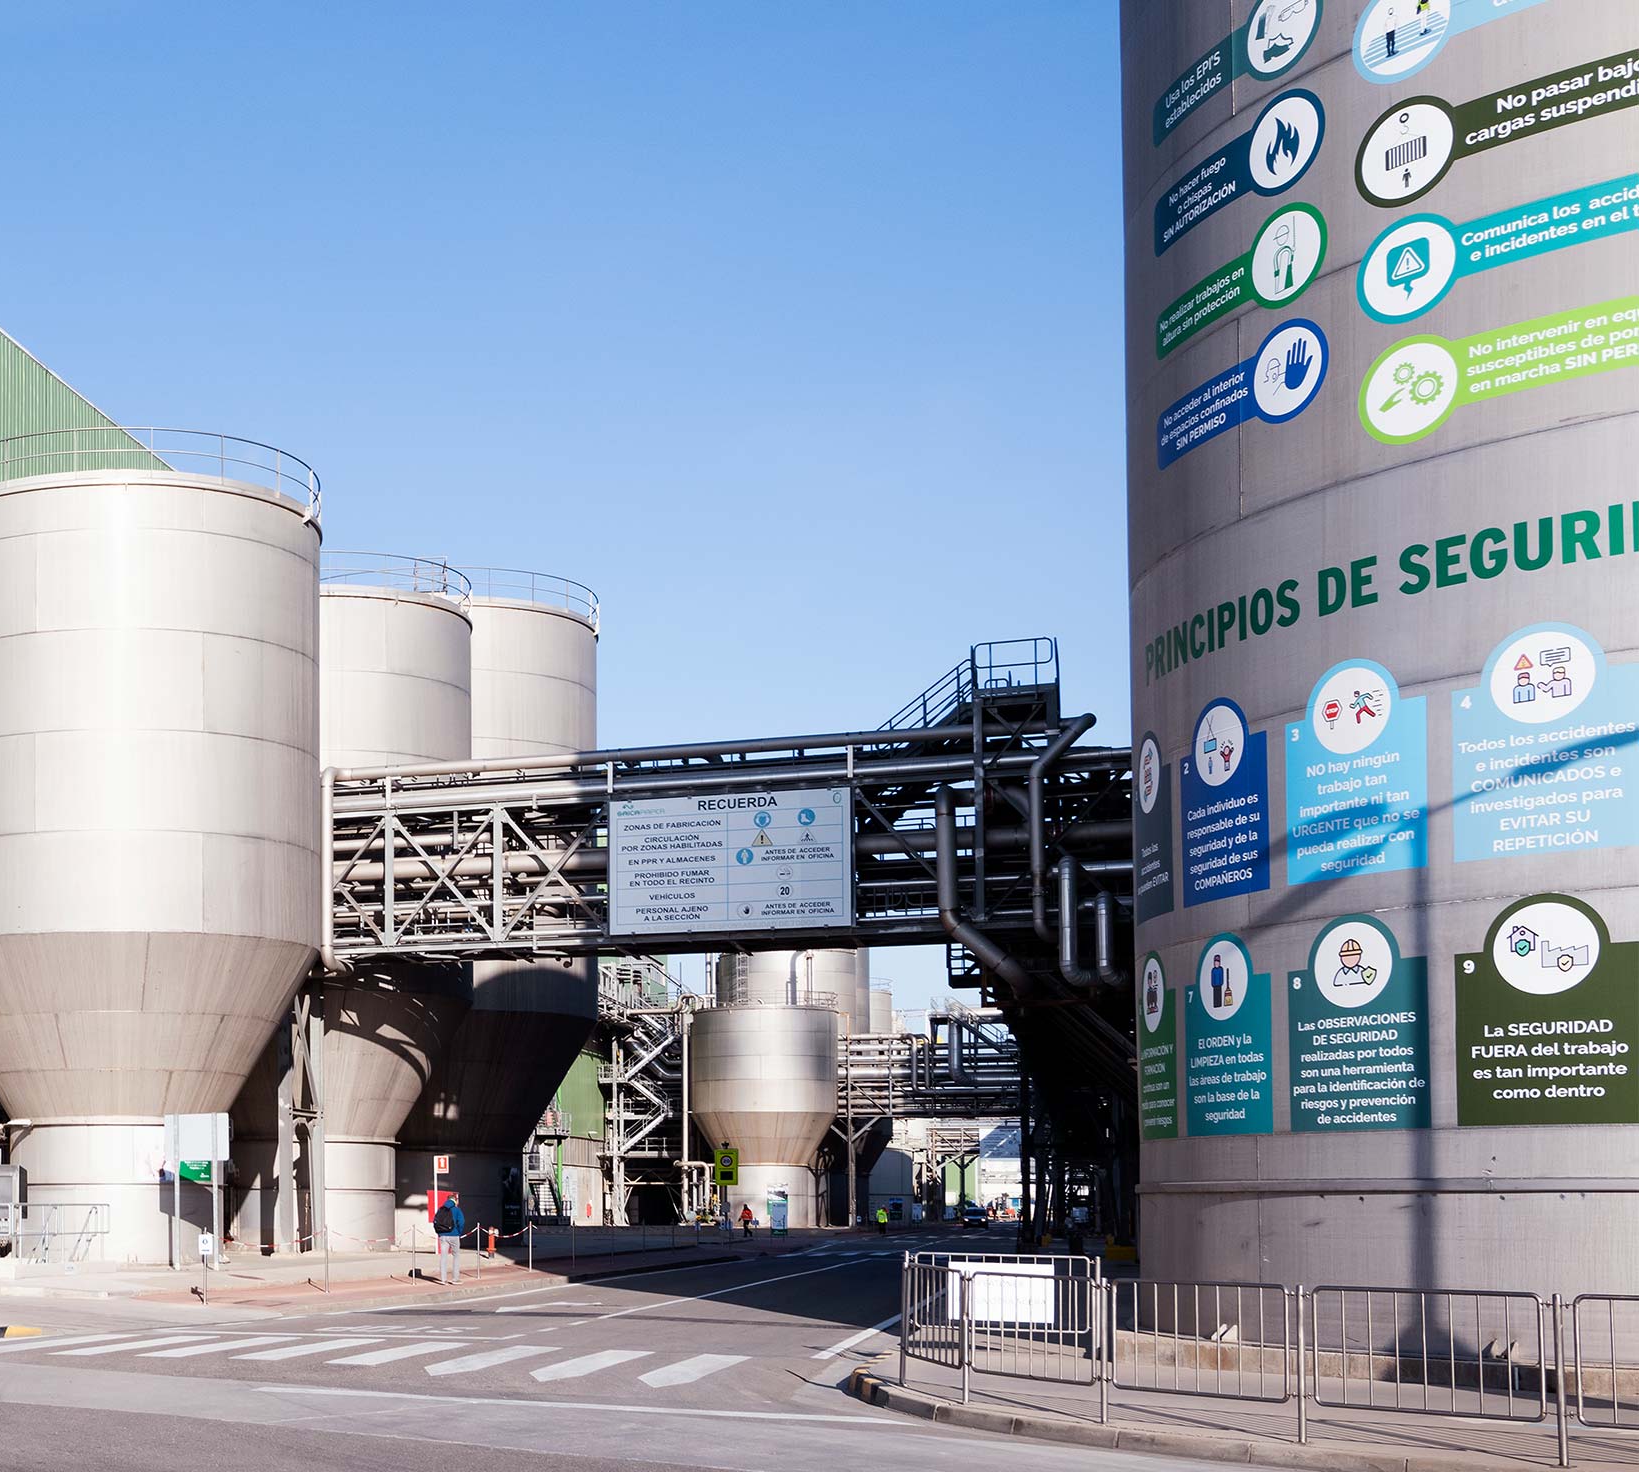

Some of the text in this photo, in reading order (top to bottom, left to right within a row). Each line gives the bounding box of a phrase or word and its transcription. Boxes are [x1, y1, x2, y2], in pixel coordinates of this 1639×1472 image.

[1165, 88, 1180, 108] Usa
[1181, 76, 1194, 92] los
[1165, 73, 1221, 128] establecidos
[1497, 95, 1526, 113] No
[1531, 72, 1593, 106] pasar
[1465, 112, 1535, 145] cargas
[1169, 157, 1226, 206] No hacer fuego
[1183, 182, 1212, 210] chispas
[1164, 181, 1236, 242] SIN AUTORIZACIÓN
[1462, 212, 1548, 246] Comunica
[1553, 203, 1580, 219] los
[1470, 206, 1629, 262] e incidentes en el
[1469, 315, 1607, 358] No intervenir en
[1466, 333, 1604, 377] susceptibles de
[1470, 379, 1491, 393] en
[1495, 363, 1560, 387] marcha
[1565, 351, 1596, 369] SIN
[1145, 501, 1639, 686] PRINCIPIOS DE SEGURI
[1461, 696, 1472, 709] 4
[1291, 729, 1299, 742] 3
[1458, 722, 1635, 754] Todos los accidentes
[1184, 763, 1189, 774] 2
[1306, 752, 1400, 778] NO hay ningún
[1476, 746, 1615, 772] e incidentes son
[1317, 774, 1387, 795] trabajo tan
[1471, 765, 1622, 793] COMUNICADOS e
[698, 796, 777, 811] RECUERDA
[1187, 794, 1258, 821] Cada individuo es
[1300, 790, 1409, 818] importante ni tan
[1471, 788, 1623, 813] investigados para
[666, 820, 721, 828] FABRICACIÓN
[1187, 812, 1260, 839] responsable de su
[1293, 809, 1420, 838] URGENTE que no se
[1500, 810, 1590, 831] EVITAR SU
[644, 835, 699, 843] CIRCULACIÓN
[670, 841, 723, 849] HABILITADAS
[1297, 830, 1414, 859] pueda realizar con
[1493, 829, 1598, 852] REPETICIÓN
[1321, 852, 1385, 872] seguridad
[1194, 868, 1252, 891] COMPAÑEROS
[780, 887, 789, 895] 20
[636, 906, 679, 914] PERSONAL
[1463, 960, 1475, 974] 9
[1293, 977, 1301, 989] 8
[1298, 1012, 1416, 1031] Las OBSERVACIONES
[1484, 1019, 1613, 1037] La SEGURIDAD
[1313, 1030, 1398, 1045] DE SEGURIDAD
[1301, 1045, 1414, 1062] realizadas por todos
[1471, 1040, 1629, 1058] FUERA del trabajo
[1301, 1062, 1414, 1078] son una herramienta
[1473, 1063, 1627, 1080] es tan importante
[1293, 1078, 1425, 1096] para la identificación de
[1493, 1085, 1606, 1099] como dentro
[1301, 1094, 1416, 1111] riesgos y prevención
[1317, 1112, 1397, 1124] de accidentes
